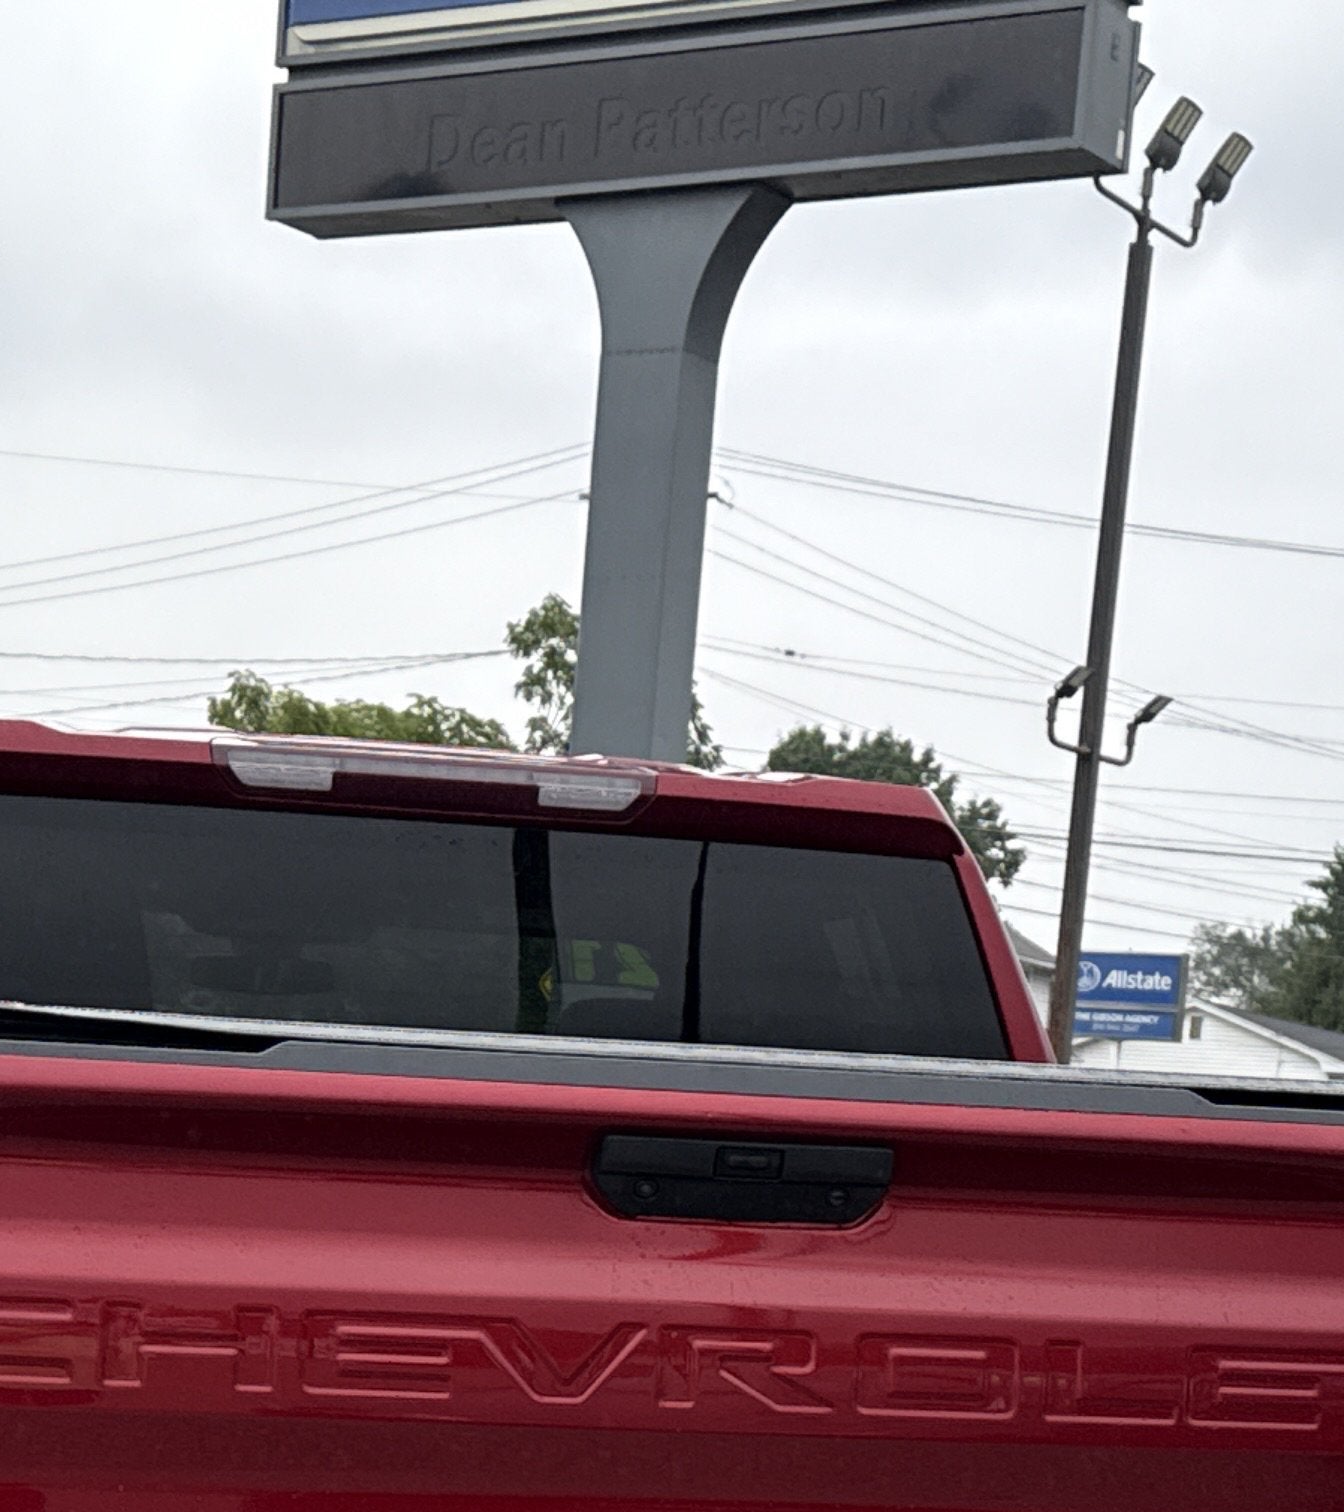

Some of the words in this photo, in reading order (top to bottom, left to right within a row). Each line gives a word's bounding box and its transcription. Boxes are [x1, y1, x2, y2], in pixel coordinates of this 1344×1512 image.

[424, 113, 567, 172] Dean
[593, 86, 891, 158] Patterson
[1102, 969, 1172, 991] Allstate
